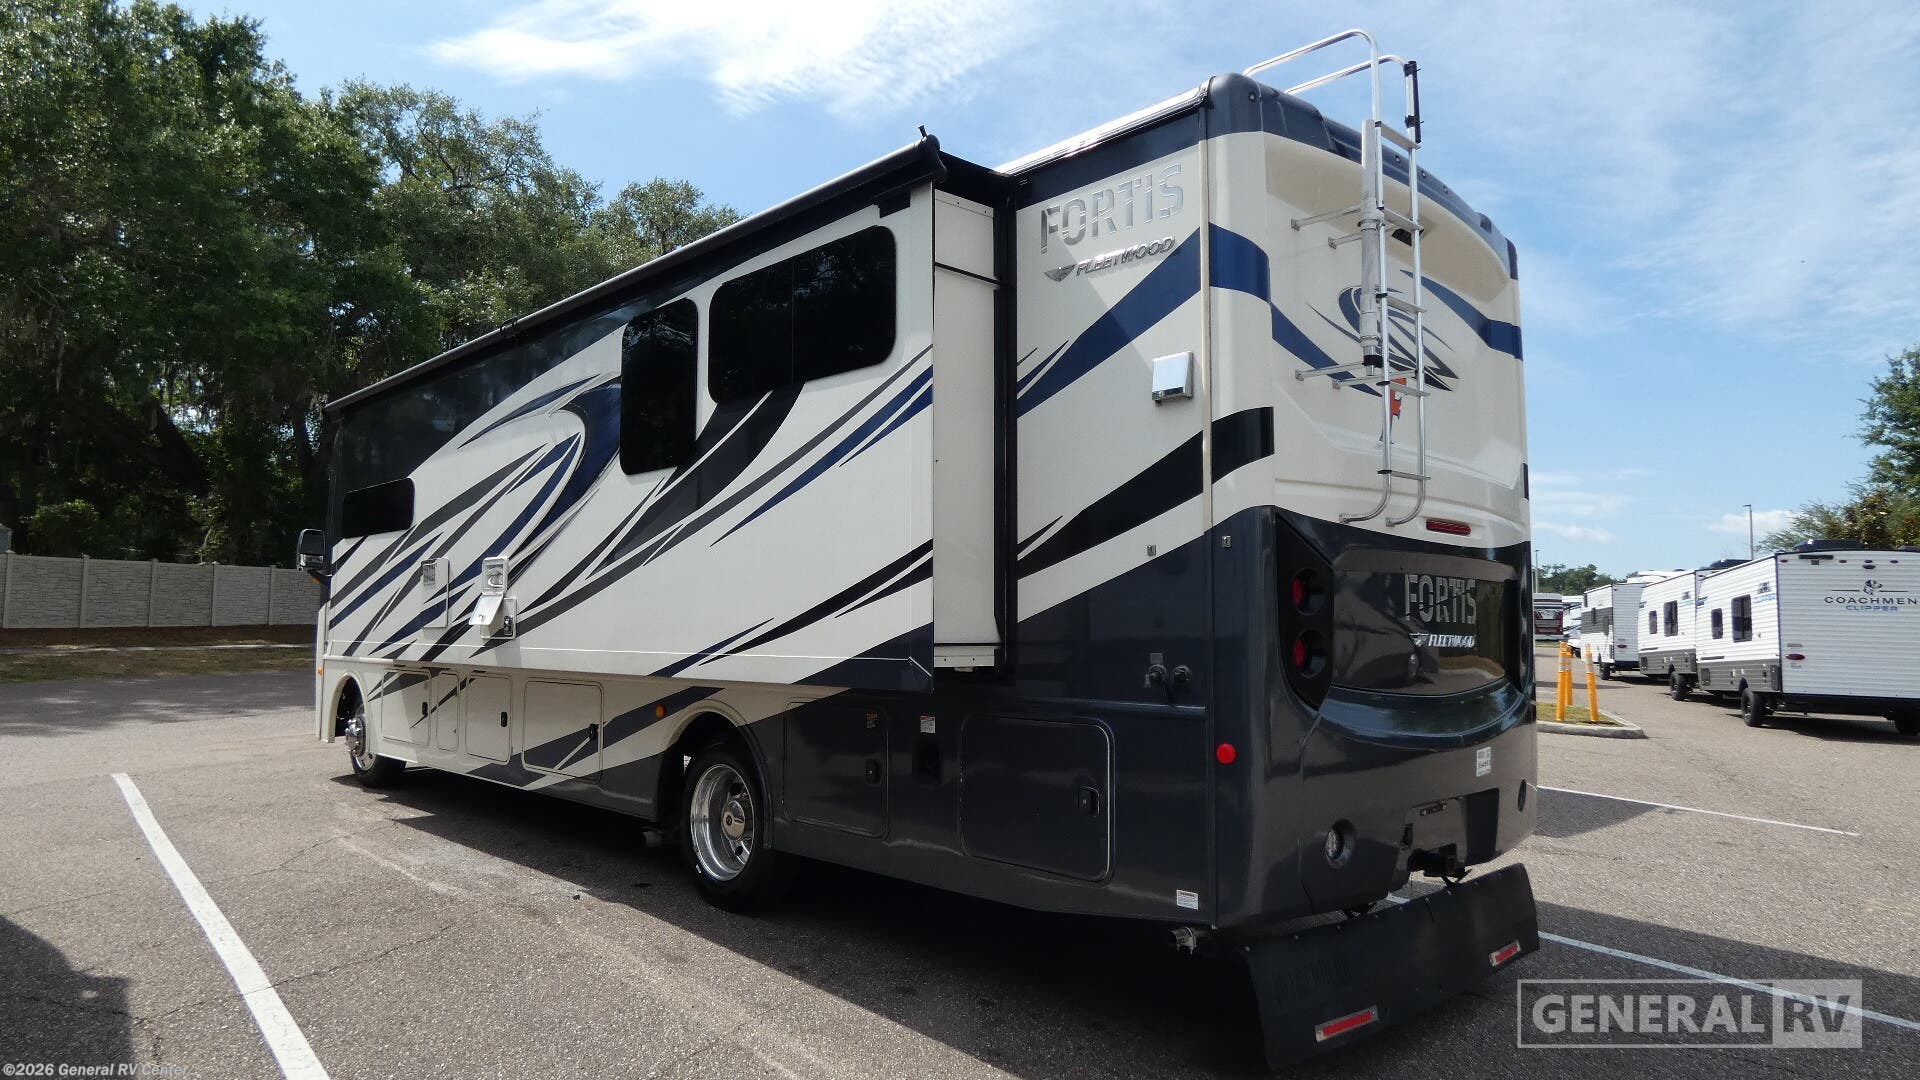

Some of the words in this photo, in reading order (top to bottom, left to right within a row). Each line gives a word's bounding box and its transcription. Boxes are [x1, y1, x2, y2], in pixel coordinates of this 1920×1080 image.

[1041, 163, 1184, 255] FORTIS
[1076, 236, 1176, 277] FLEETWOOD
[1404, 573, 1477, 625] FORTIS
[1824, 596, 1917, 605] COACHMEN
[1428, 634, 1476, 648] FLEETWOOD
